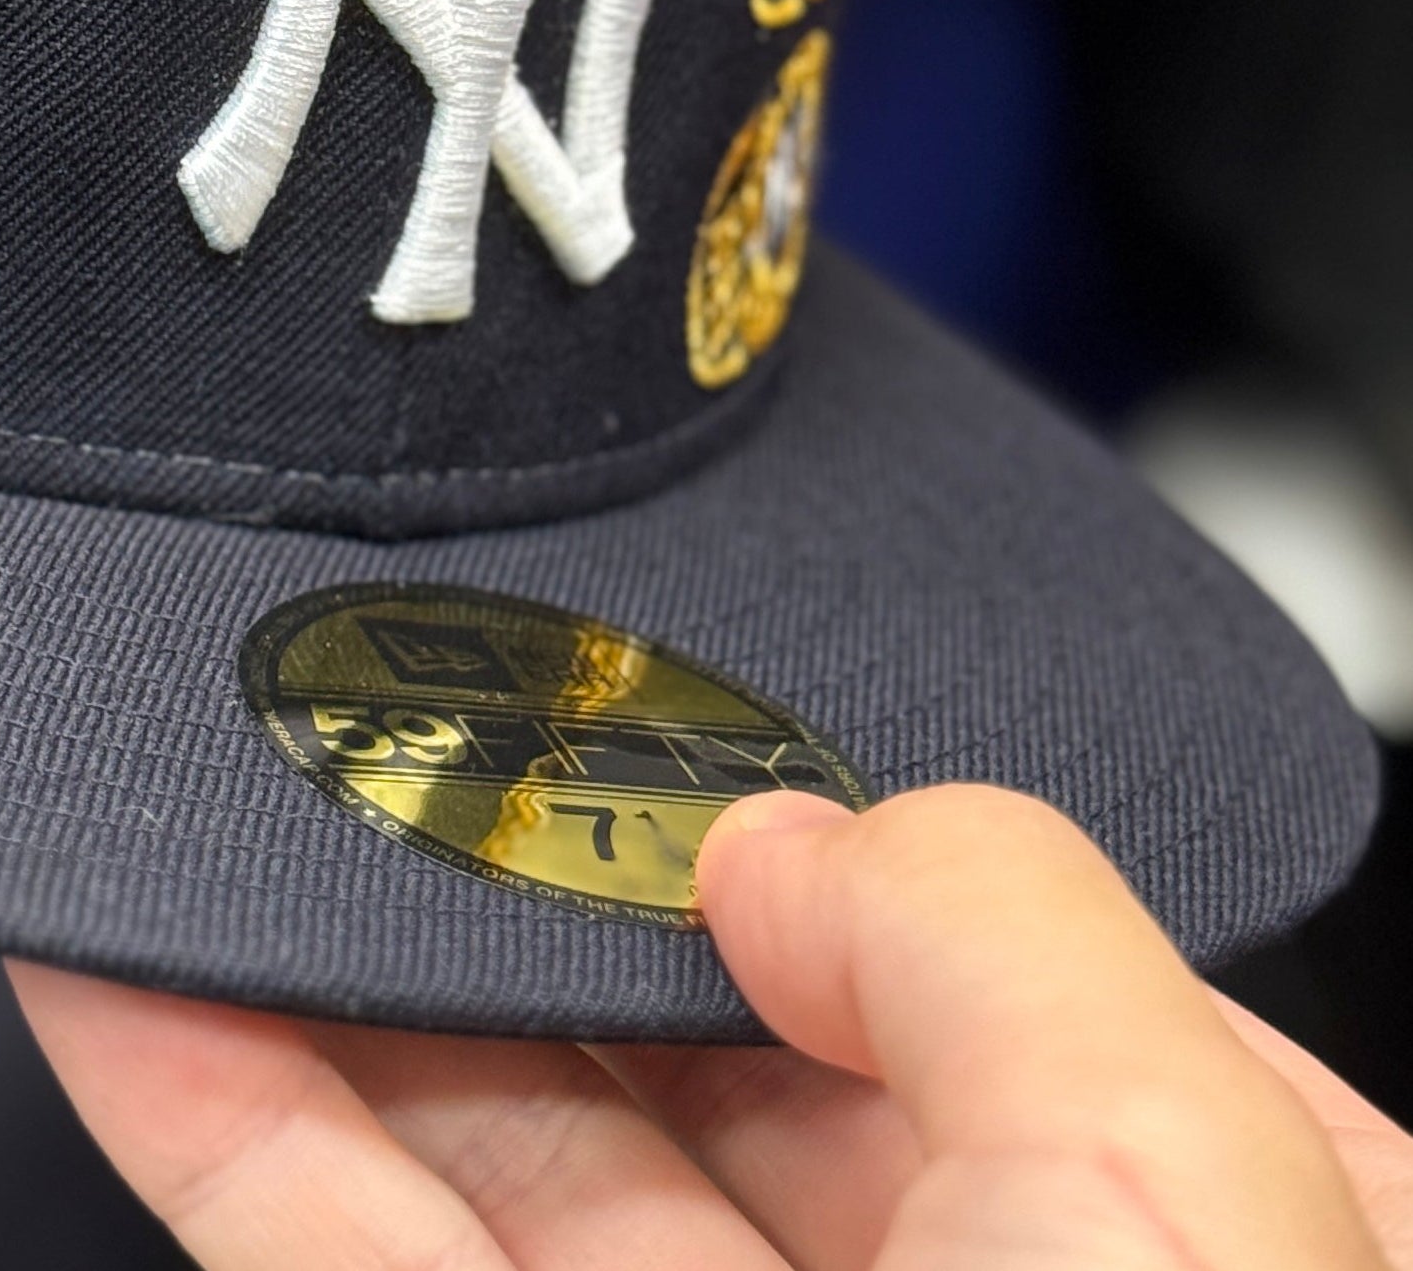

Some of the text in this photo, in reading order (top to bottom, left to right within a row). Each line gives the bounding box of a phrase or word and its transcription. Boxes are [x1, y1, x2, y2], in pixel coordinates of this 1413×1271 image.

[310, 703, 787, 790] 59FIFTY
[381, 819, 531, 892] ORIGINATORS
[536, 885, 567, 903] OF
[572, 894, 619, 915] THE
[622, 905, 685, 926] TRUE
[547, 802, 618, 862] 7
